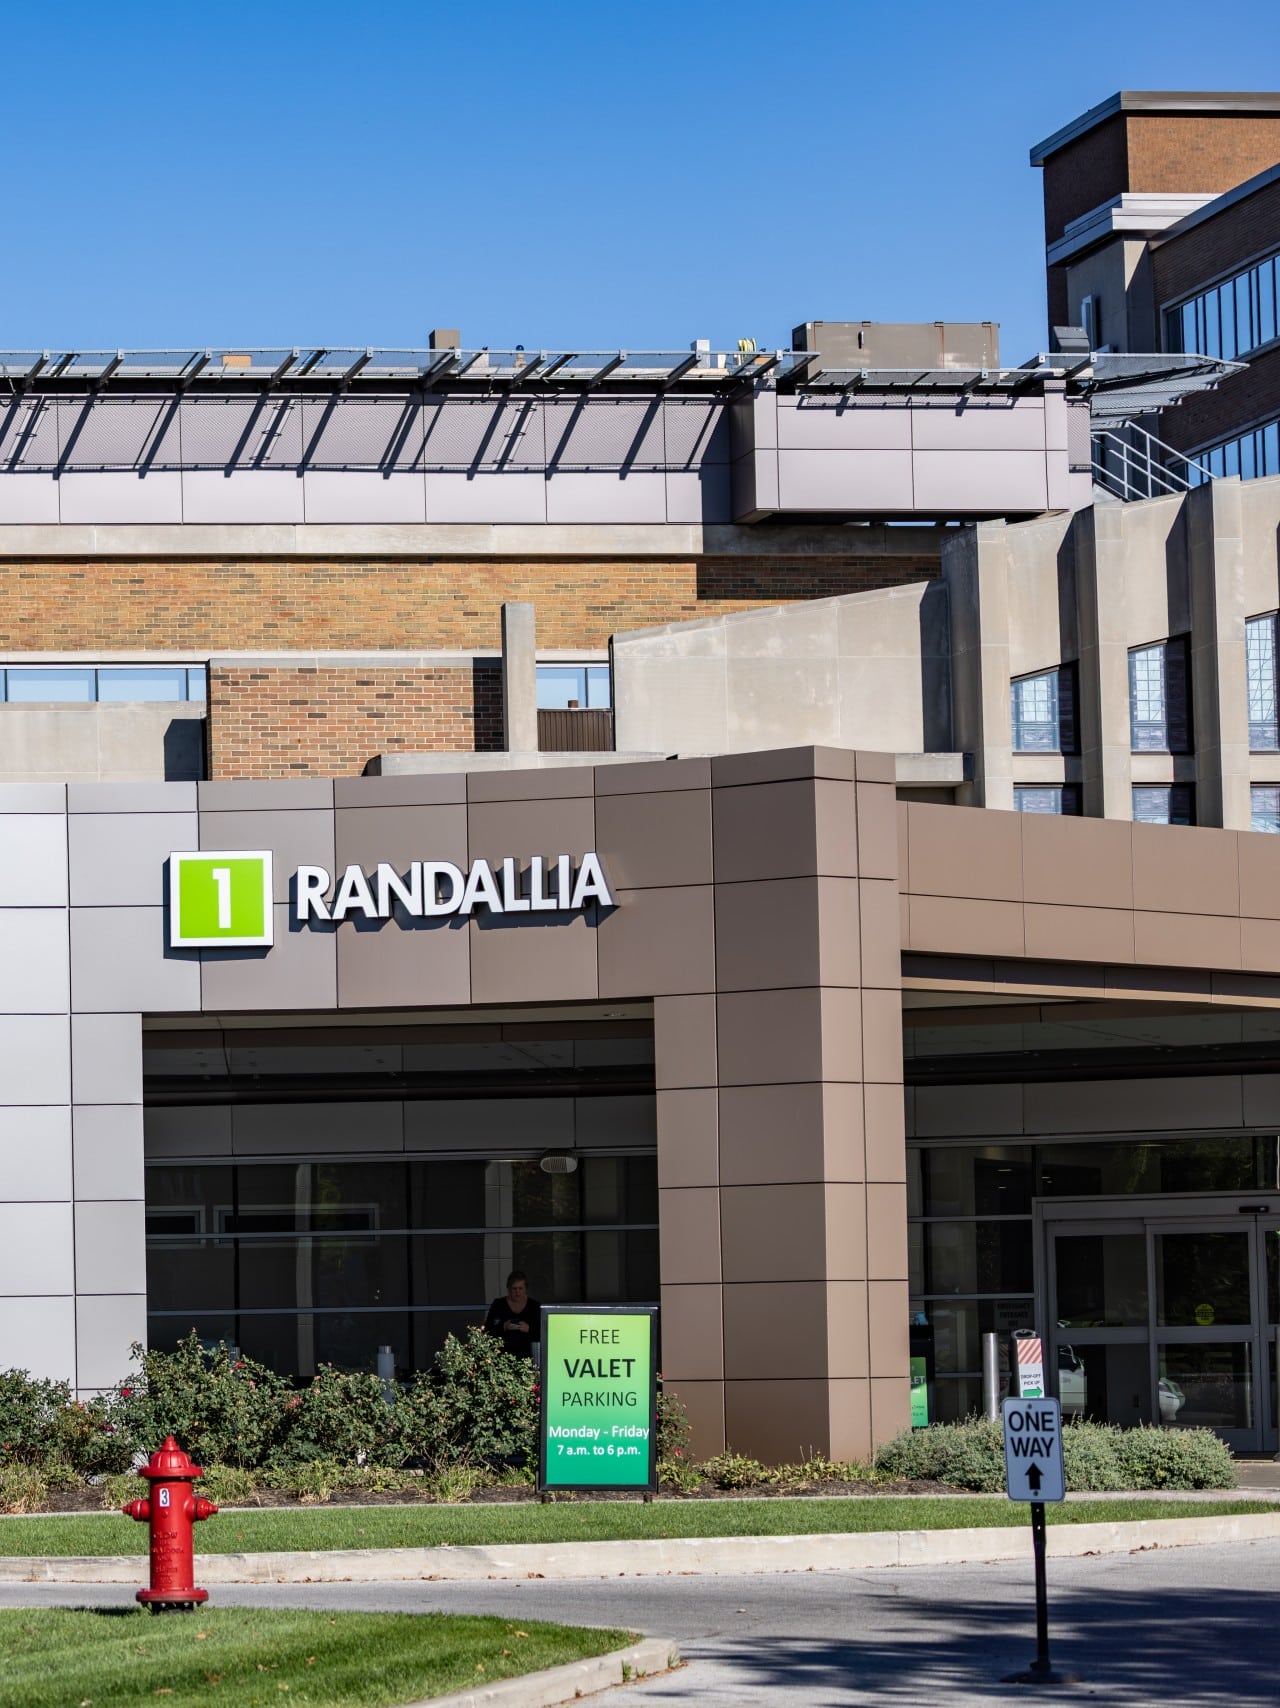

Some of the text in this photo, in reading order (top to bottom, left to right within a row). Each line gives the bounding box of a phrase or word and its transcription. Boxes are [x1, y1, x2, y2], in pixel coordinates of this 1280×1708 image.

[296, 852, 614, 919] RANDALLIA
[211, 868, 232, 929] 1
[579, 1329, 620, 1344] FREE
[563, 1358, 636, 1378] VALET
[562, 1391, 637, 1407] PARKING
[1008, 1411, 1055, 1432] ONE
[549, 1425, 600, 1440] Monday
[612, 1425, 649, 1440] Friday
[557, 1444, 641, 1458] 7 a.m. to 6 p.m.
[1010, 1436, 1055, 1458] WAY
[161, 1489, 169, 1505] 3
